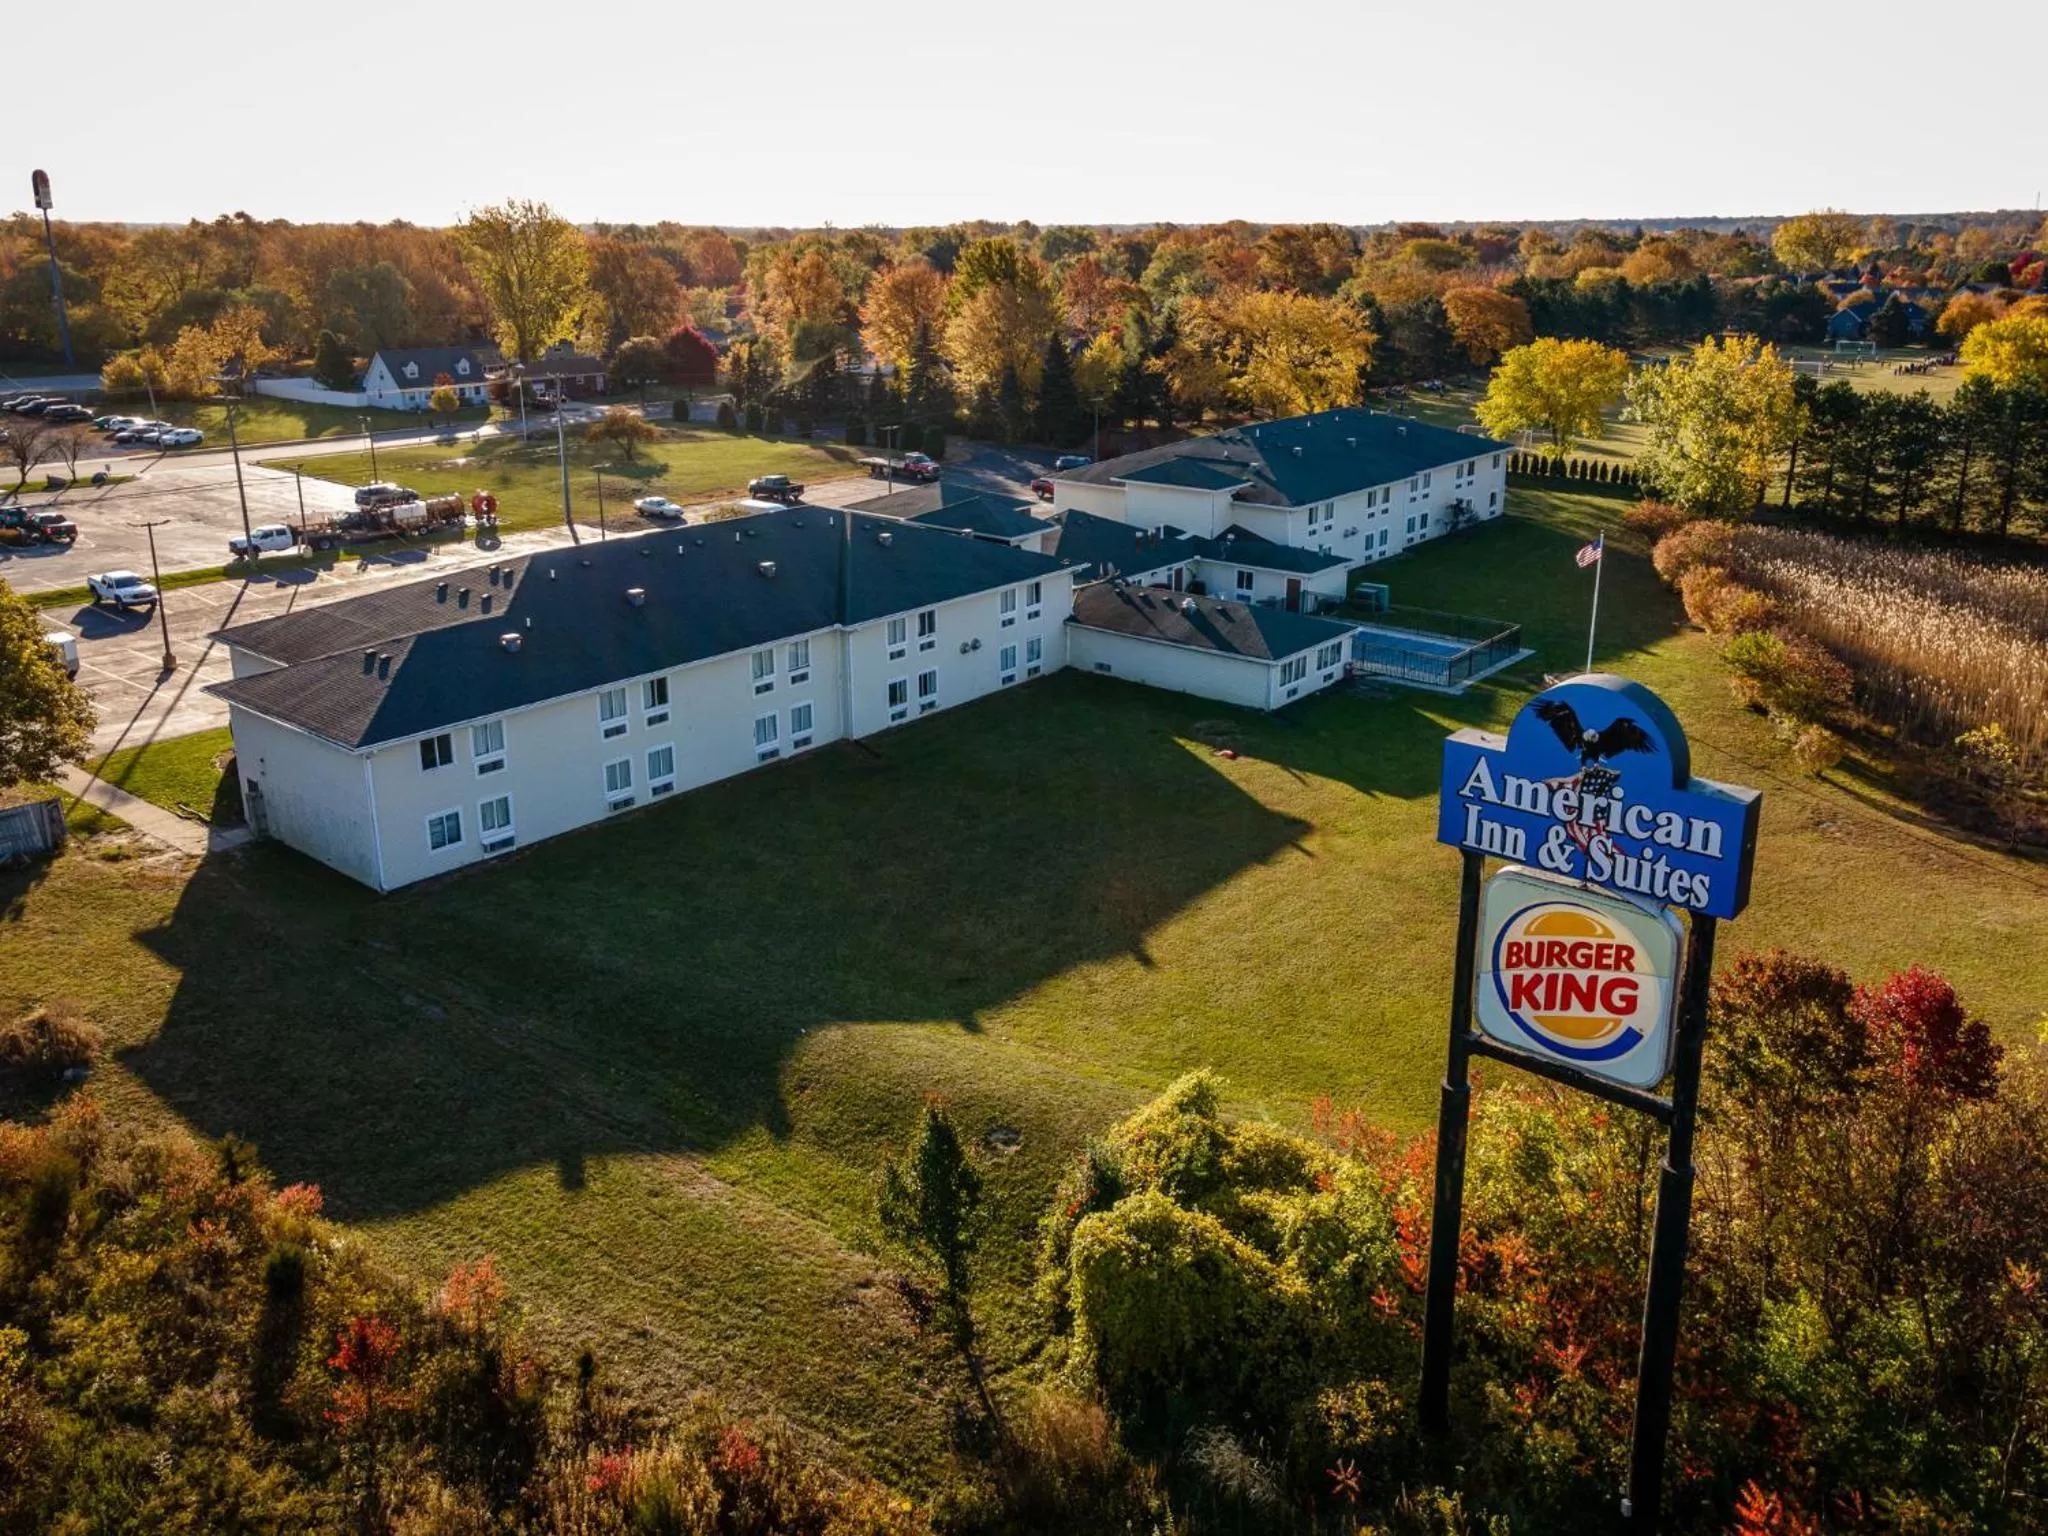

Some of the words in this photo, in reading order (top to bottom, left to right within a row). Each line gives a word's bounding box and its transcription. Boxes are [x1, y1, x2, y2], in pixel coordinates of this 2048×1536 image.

[1458, 756, 1722, 859] American
[1461, 804, 1527, 861] Inn
[1537, 825, 1574, 873] &
[1586, 834, 1711, 909] Suites
[1505, 941, 1635, 972] BURGER
[1511, 973, 1639, 1016] KING
